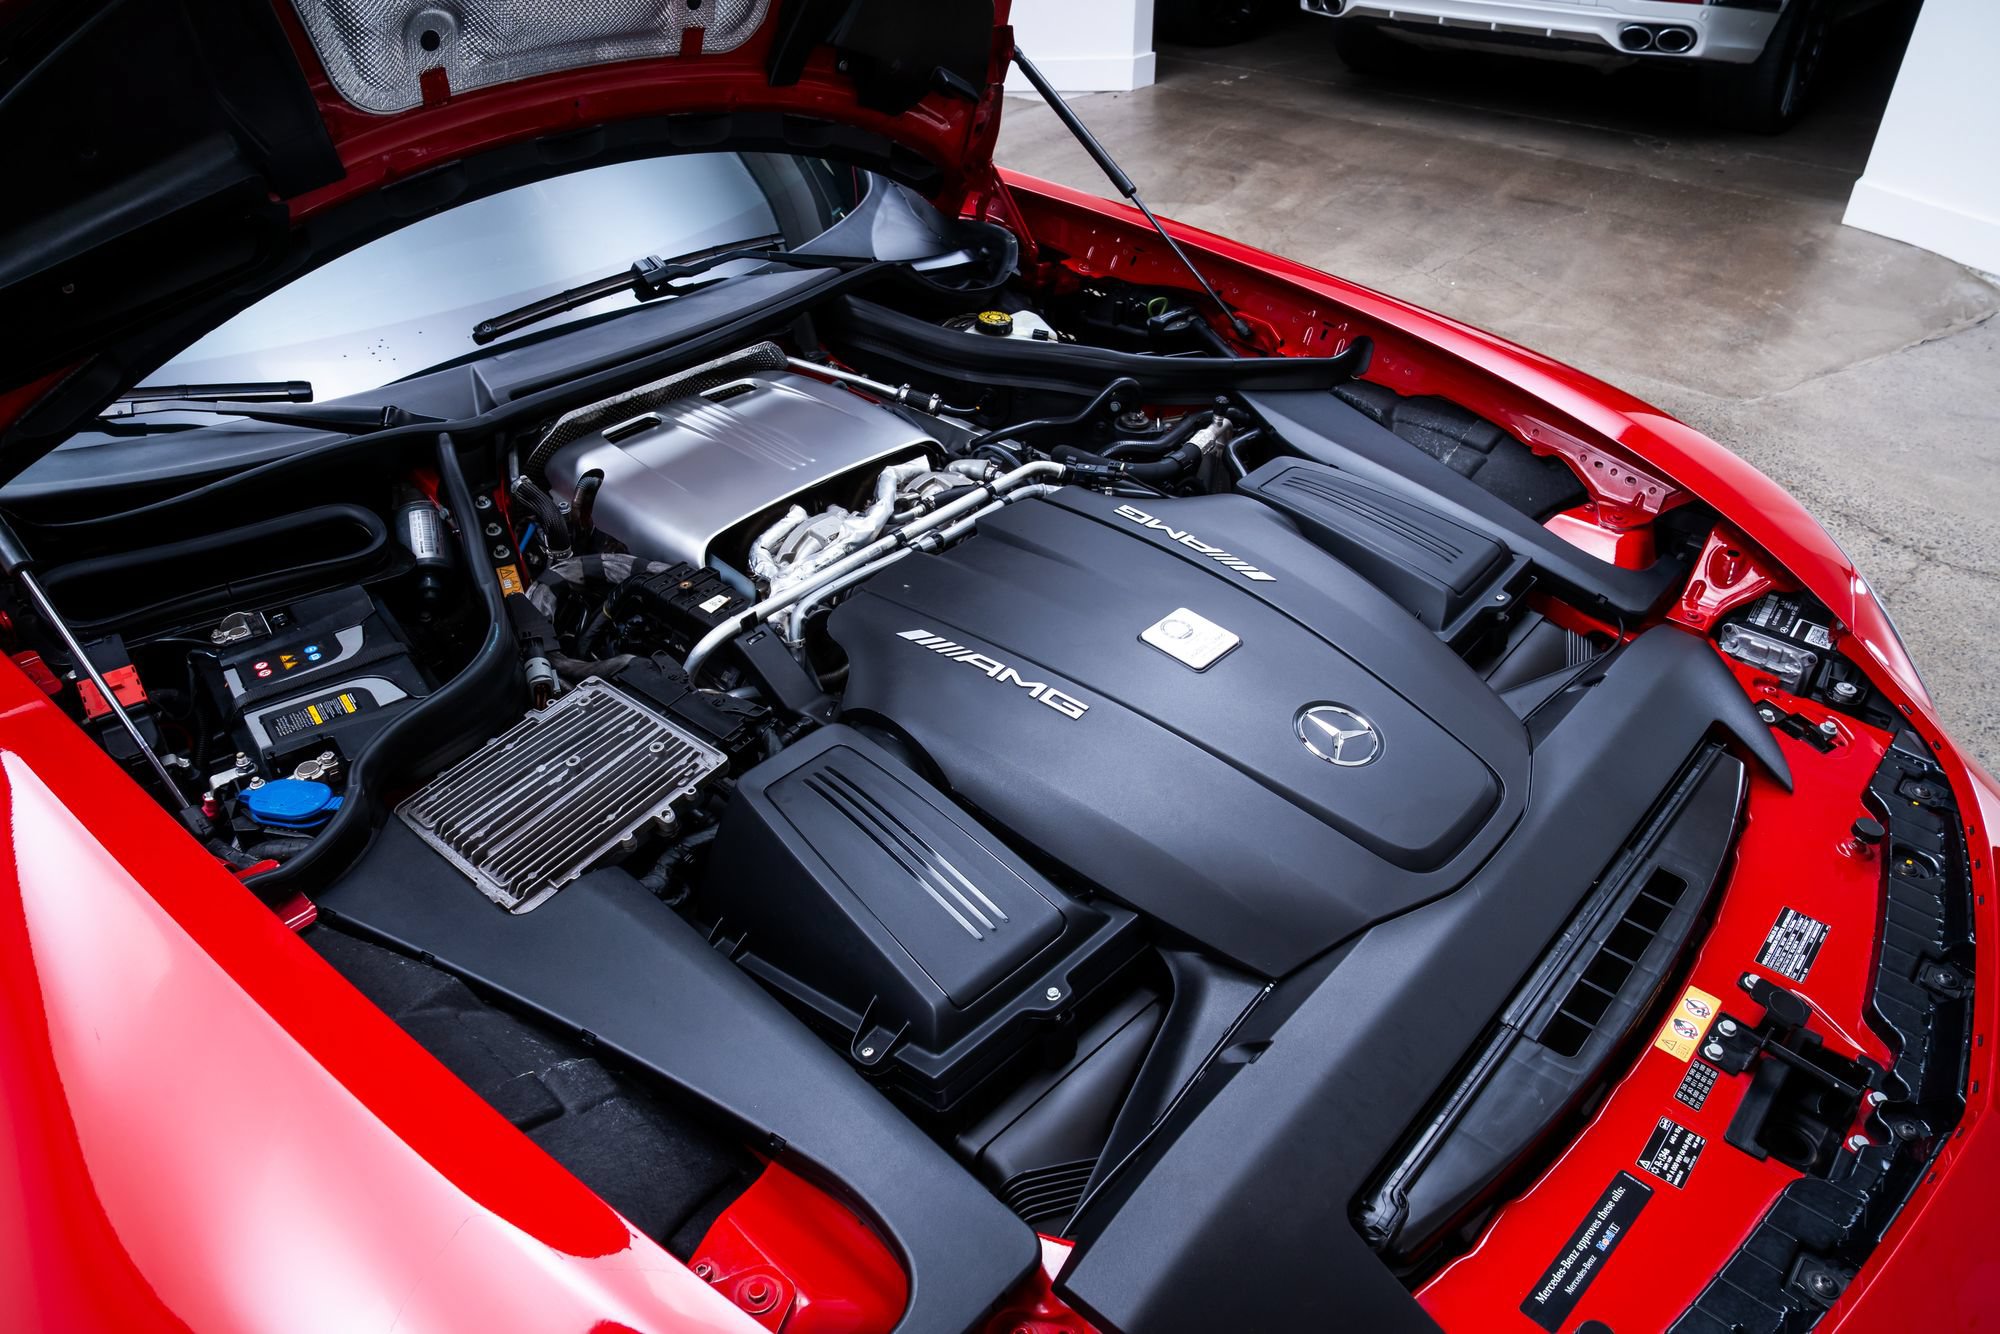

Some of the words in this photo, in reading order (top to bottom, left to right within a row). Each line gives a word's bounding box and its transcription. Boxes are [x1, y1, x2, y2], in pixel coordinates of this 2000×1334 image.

[1654, 1148, 1670, 1167] R-134a
[1535, 1249, 1580, 1304] Mercedes-Benz
[1576, 1219, 1602, 1251] approves
[1597, 1201, 1615, 1220] these
[1612, 1186, 1626, 1202] oils:
[1565, 1255, 1597, 1295] Mercedes-Benz
